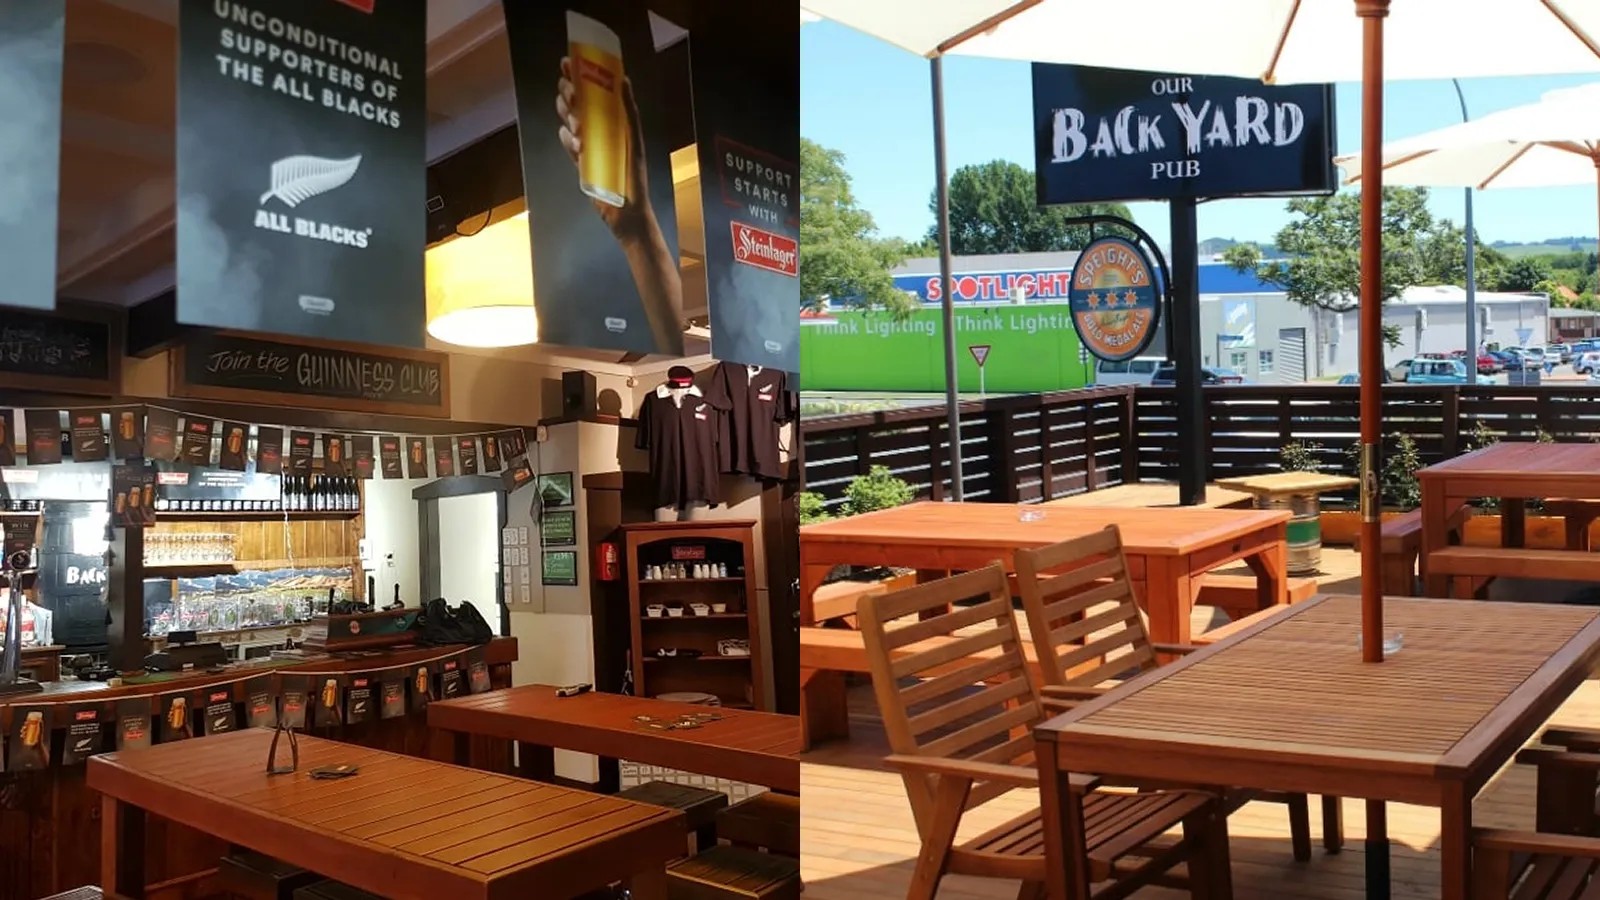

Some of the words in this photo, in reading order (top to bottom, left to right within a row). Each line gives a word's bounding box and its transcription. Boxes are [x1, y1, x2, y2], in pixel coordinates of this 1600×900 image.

[214, 0, 402, 80] UNCONDITIONAL
[220, 28, 365, 92] SUPPORTERS
[371, 80, 398, 101] OF
[216, 54, 264, 86] THE
[272, 73, 315, 101] ALL
[321, 88, 401, 128] BLACKS
[1151, 77, 1194, 96] OUR
[1051, 105, 1167, 164] BACK
[1171, 95, 1305, 155] YARD
[725, 152, 792, 189] SUPPORT
[1150, 160, 1200, 180] PUB
[734, 177, 788, 207] STARTS
[254, 209, 293, 233] ALL
[295, 217, 368, 248] BLACKS
[748, 203, 778, 223] WITH
[736, 228, 795, 270] Steinlager
[1080, 248, 1144, 285] SPEIGHT'S
[956, 313, 1004, 331] Think
[1010, 310, 1074, 334] Lightin
[207, 350, 251, 373] Join
[256, 352, 290, 373] the
[296, 352, 395, 392] GUINNESS
[399, 364, 439, 396] CLUB
